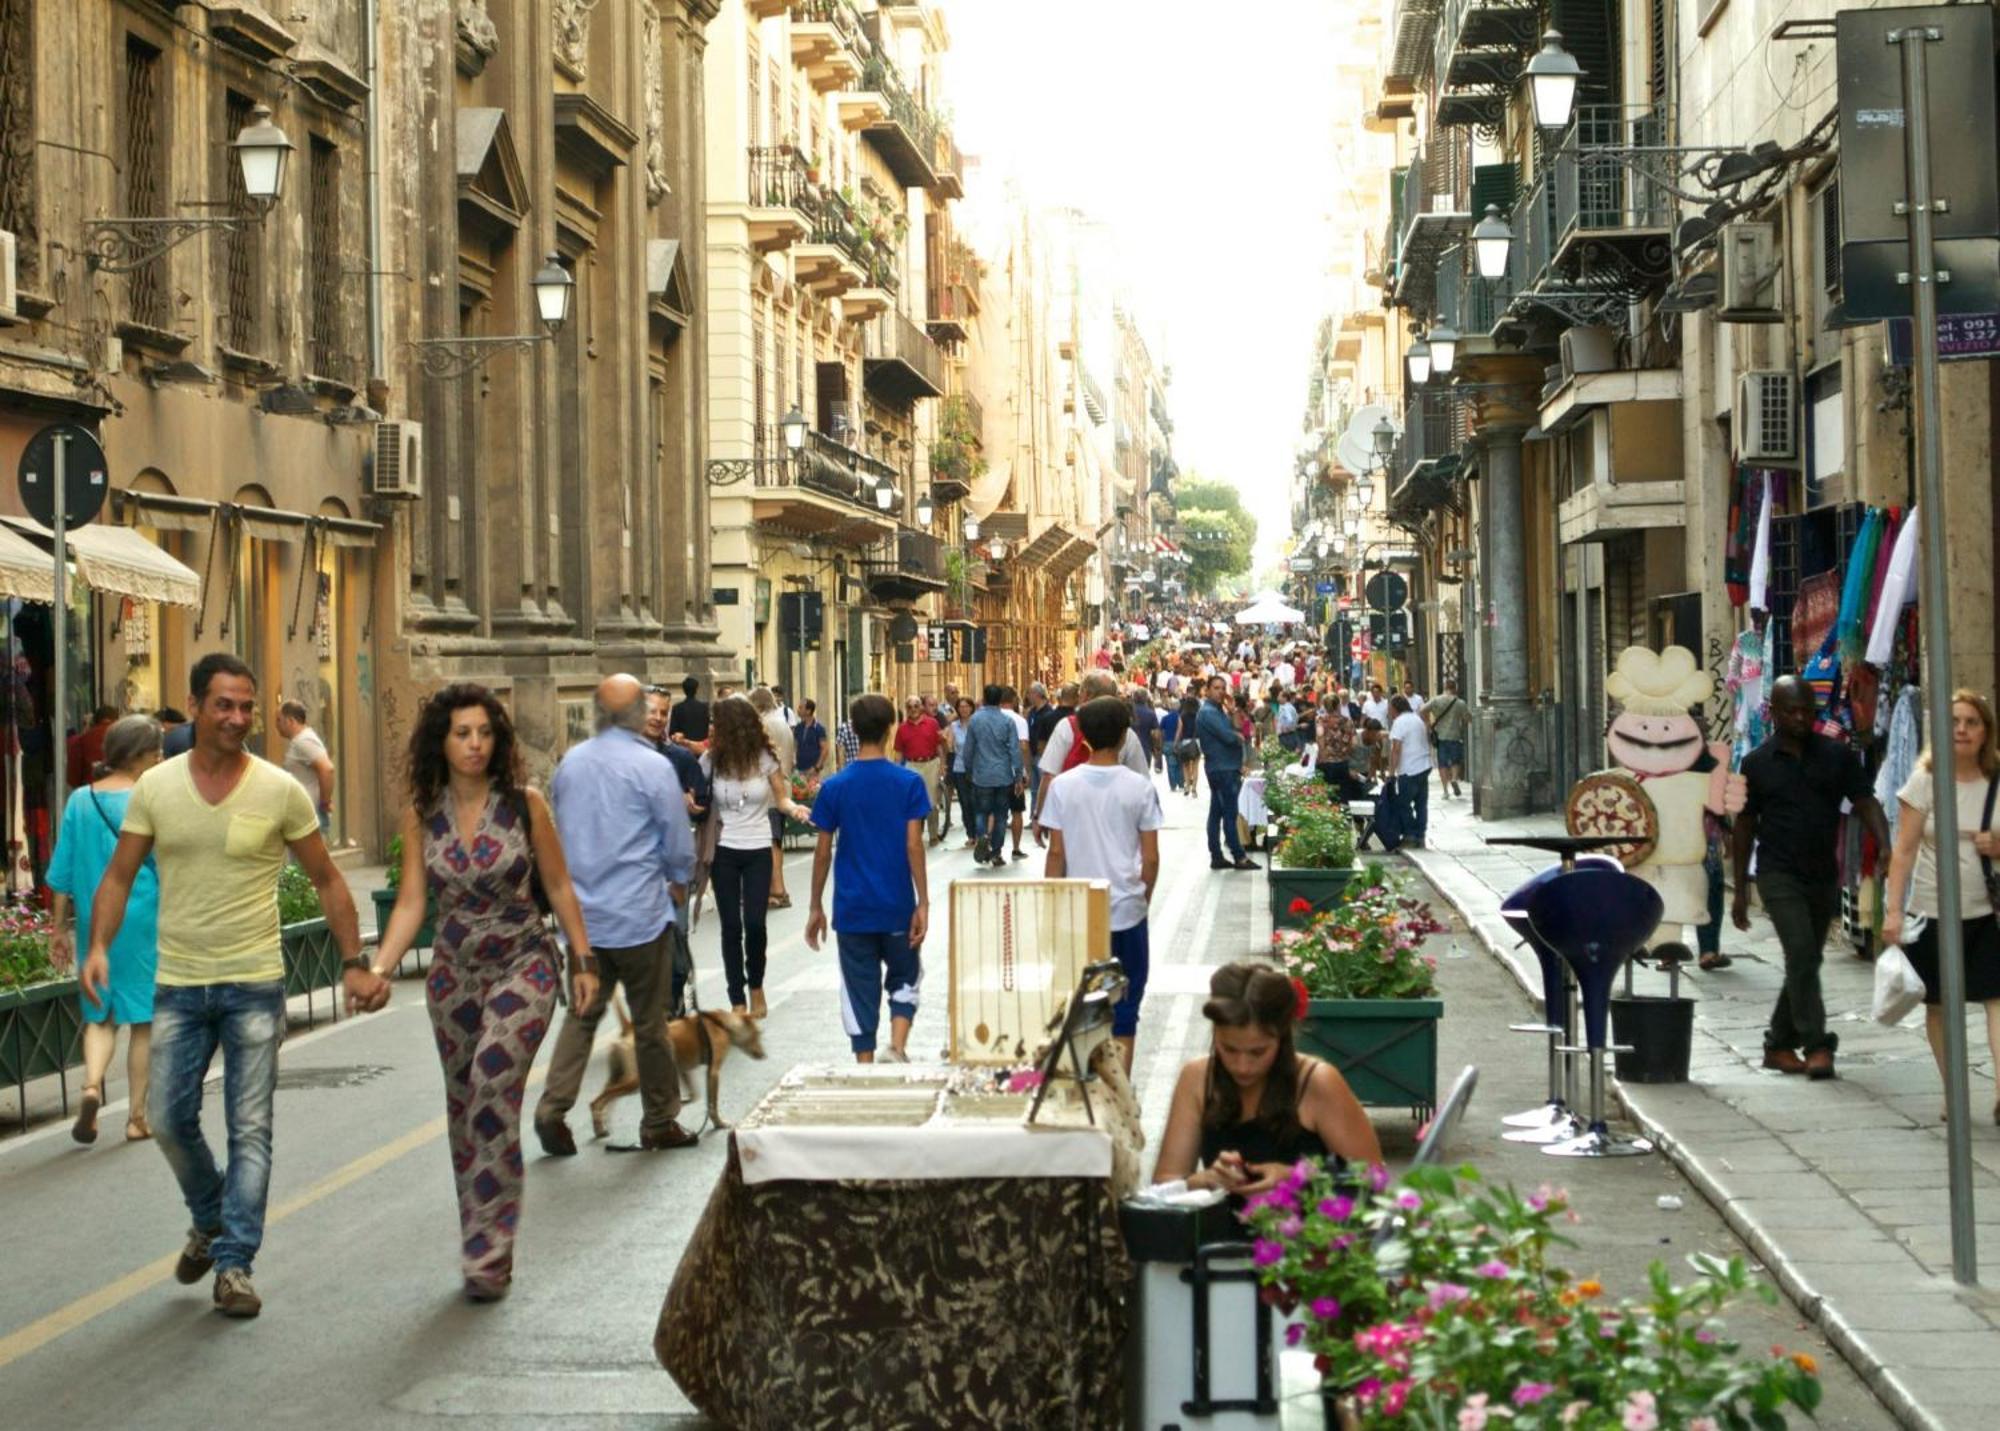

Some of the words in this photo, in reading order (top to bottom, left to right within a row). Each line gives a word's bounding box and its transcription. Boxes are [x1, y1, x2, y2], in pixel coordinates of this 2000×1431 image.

[1937, 321, 1958, 332] el.
[1963, 319, 1995, 330] 091
[1938, 332, 1958, 342] el.
[1964, 330, 1996, 341] 327
